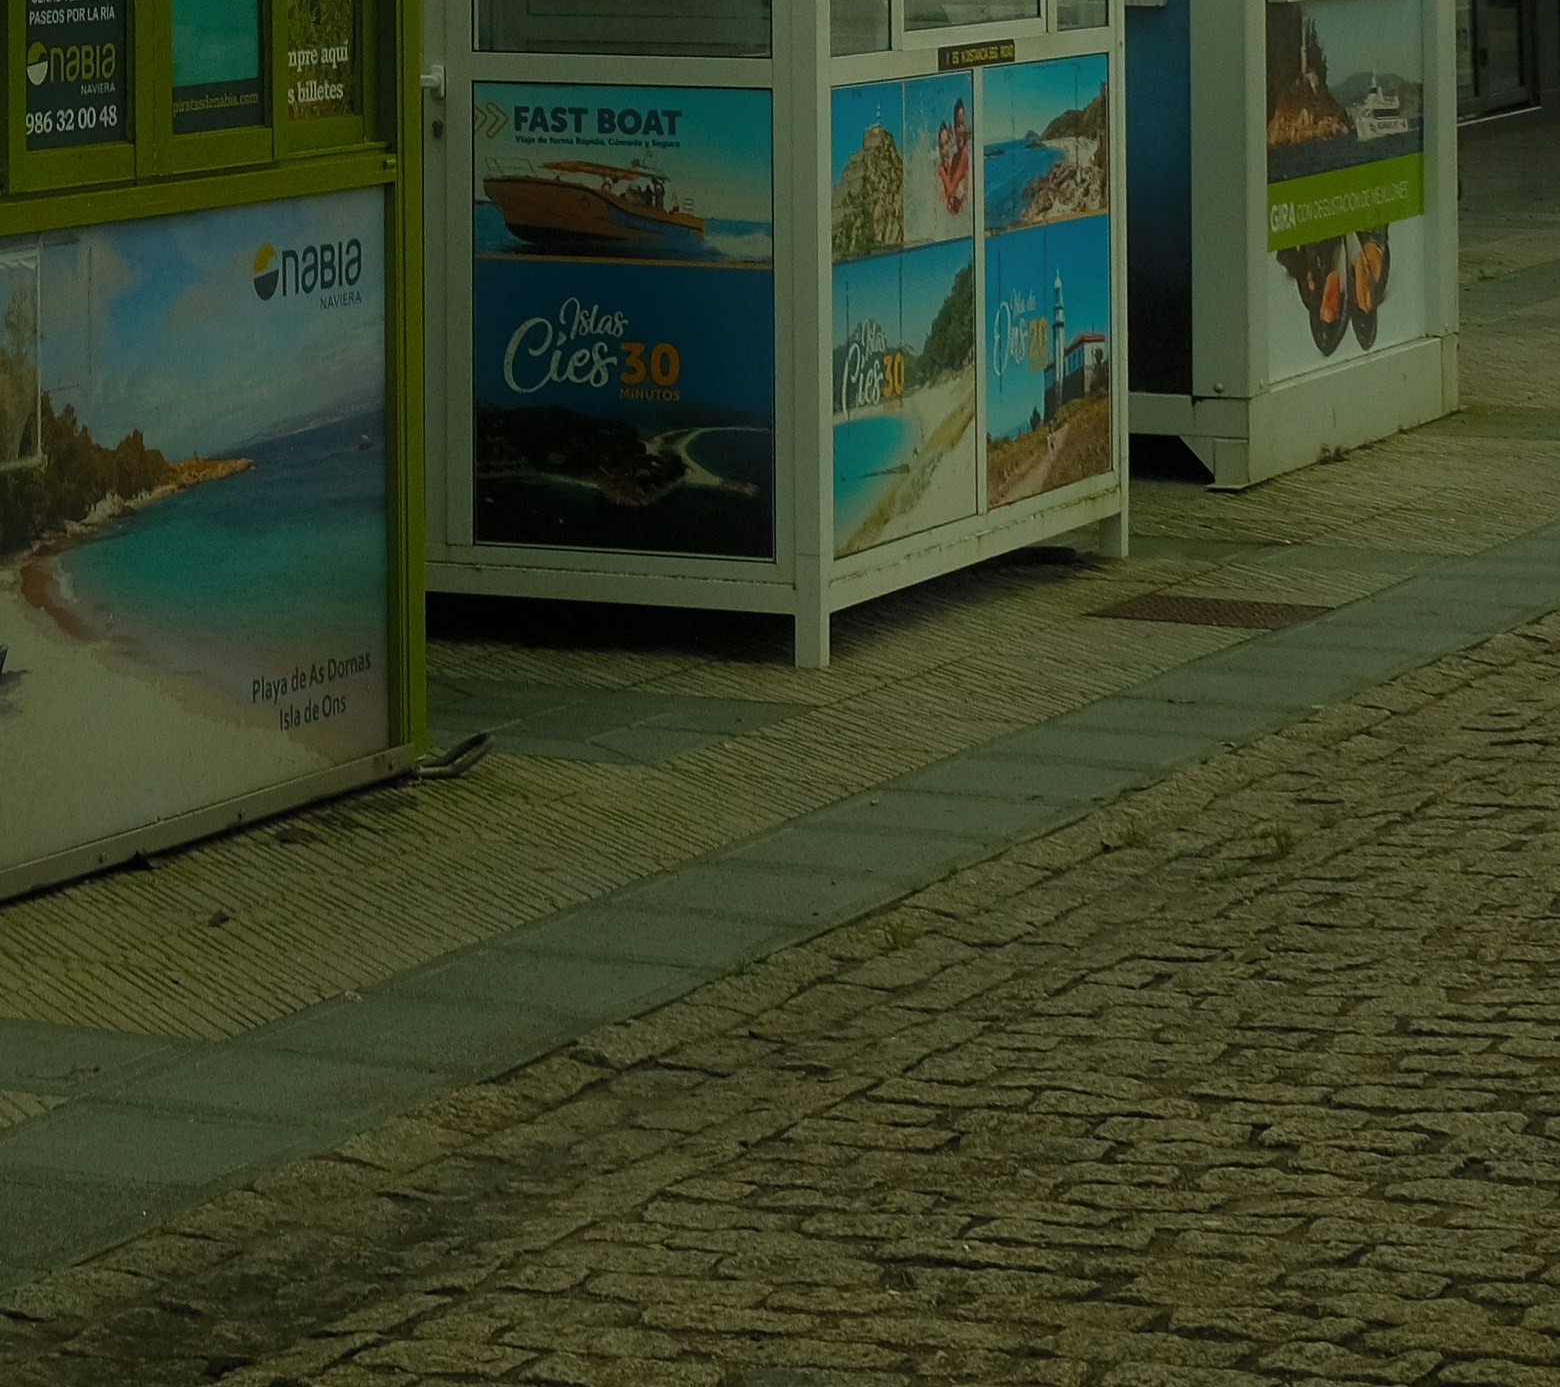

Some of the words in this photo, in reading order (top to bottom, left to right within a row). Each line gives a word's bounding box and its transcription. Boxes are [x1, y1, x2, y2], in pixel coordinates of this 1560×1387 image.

[28, 10, 65, 26] PASEOS
[66, 8, 85, 24] POR
[86, 8, 99, 23] LA
[513, 105, 589, 133] FAST
[596, 107, 683, 137] BOAT
[558, 296, 630, 341] Islas
[619, 340, 683, 388] 30
[619, 387, 681, 403] MINUTOS
[251, 673, 288, 706] Playa
[290, 666, 307, 691] de
[308, 662, 325, 687] As
[326, 648, 372, 681] Dornas
[279, 697, 301, 731] Isla
[303, 695, 320, 725] de
[320, 690, 347, 719] Ons
